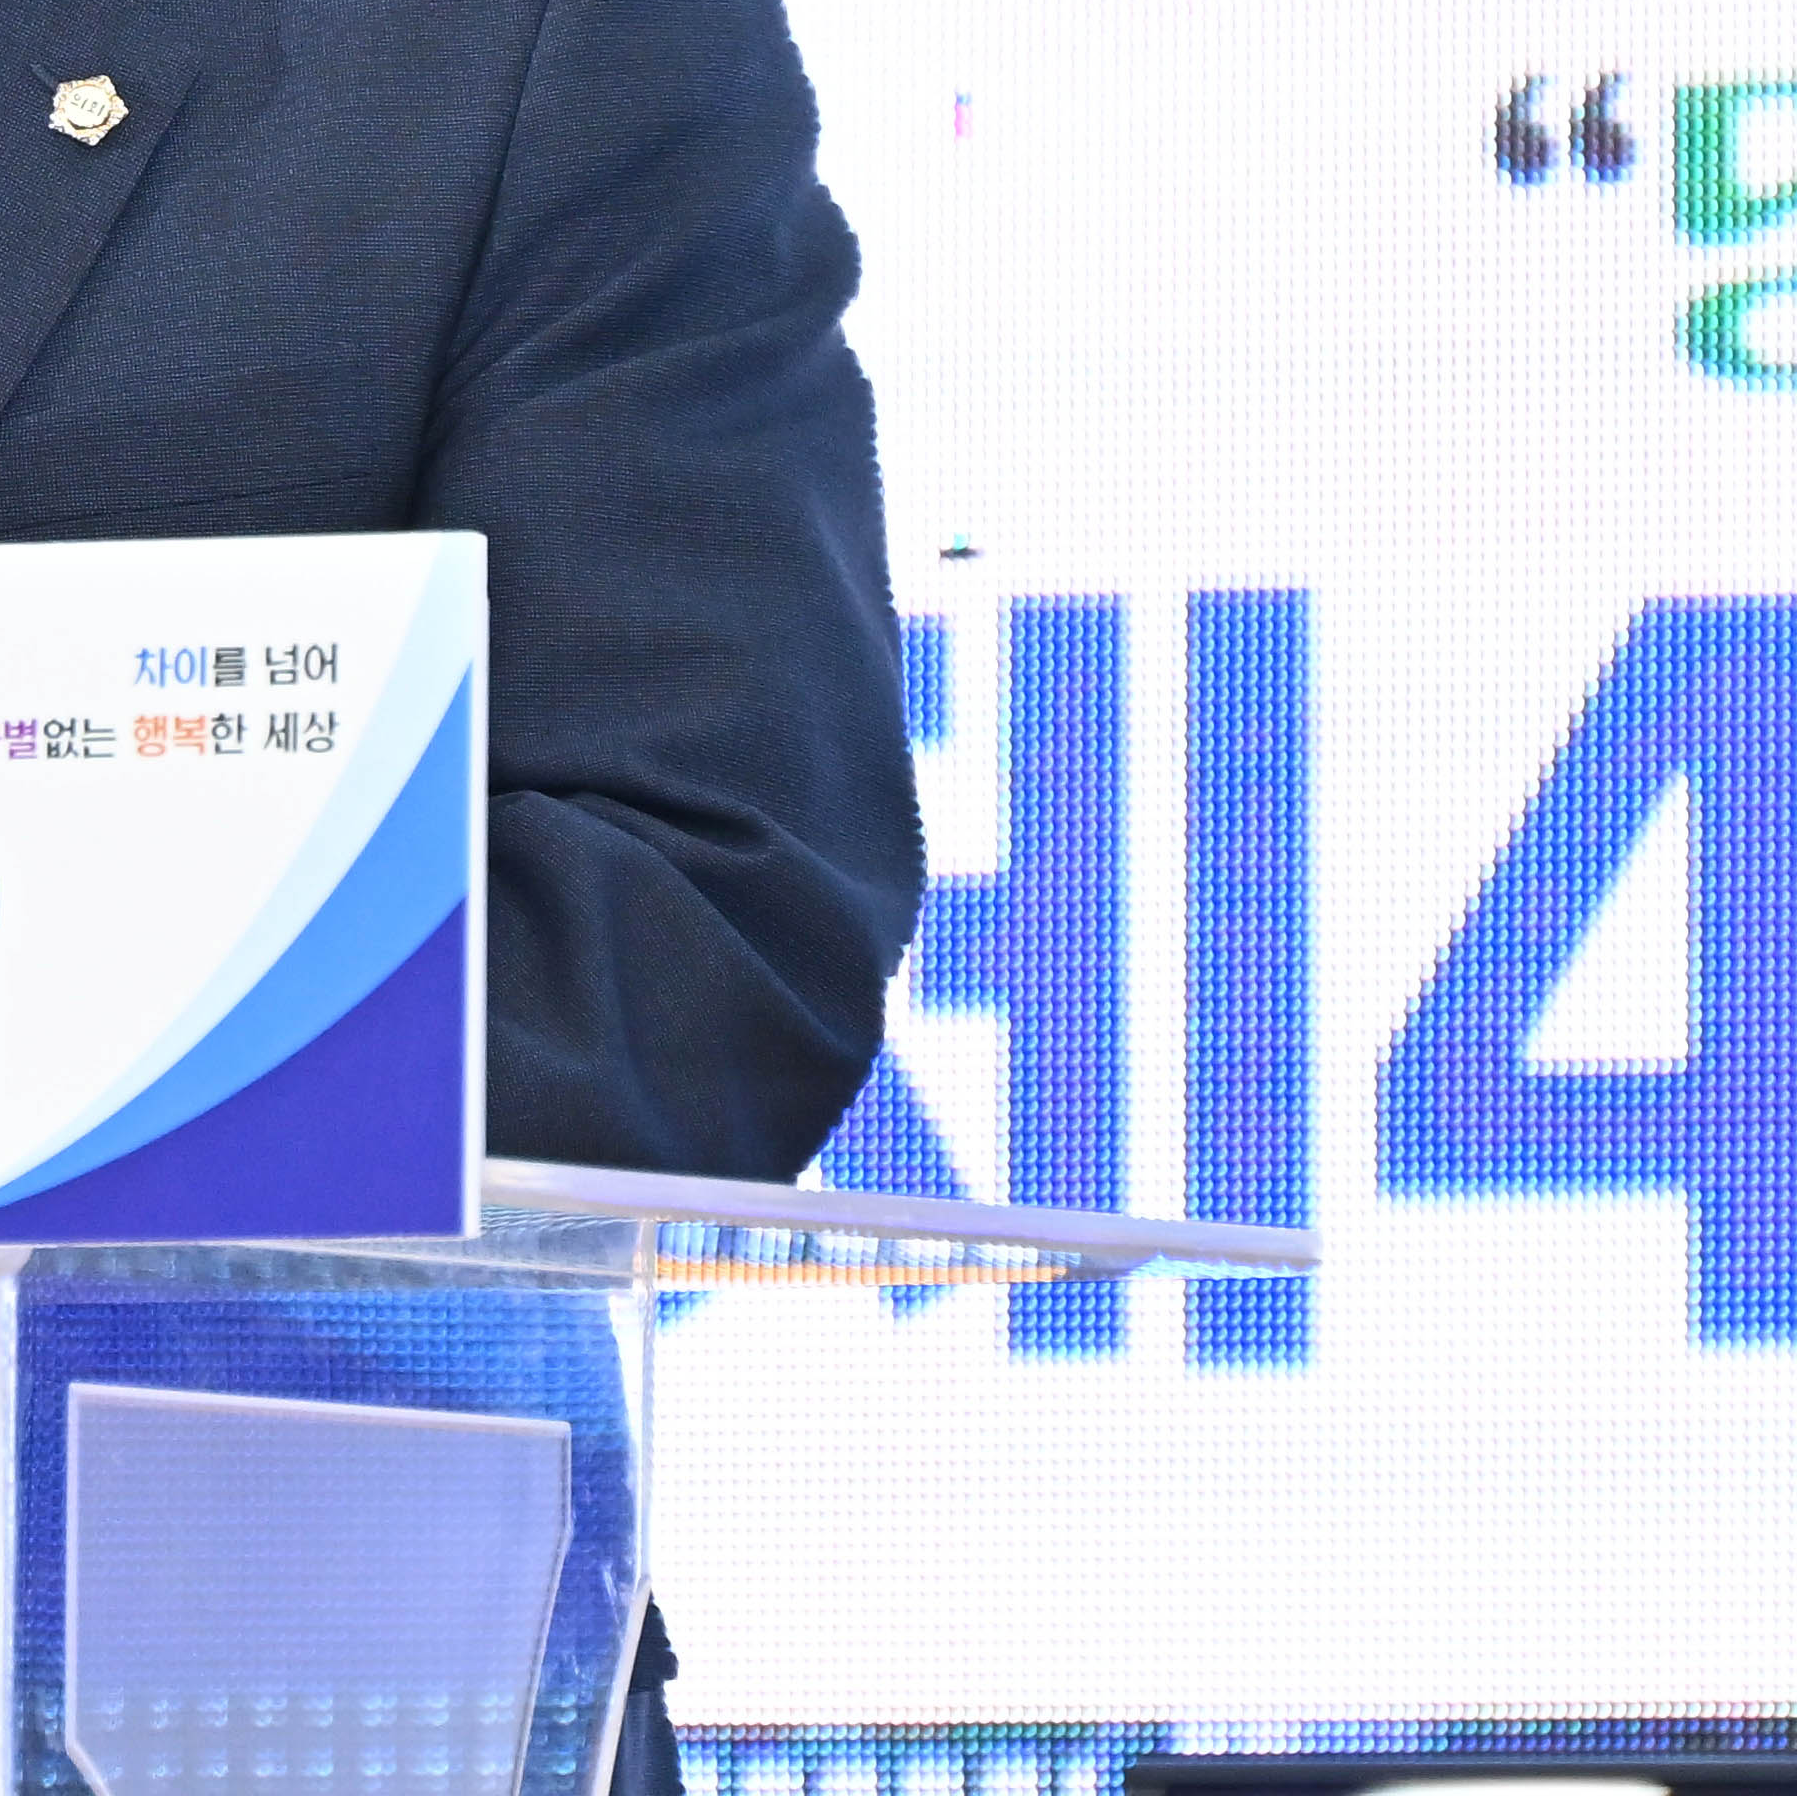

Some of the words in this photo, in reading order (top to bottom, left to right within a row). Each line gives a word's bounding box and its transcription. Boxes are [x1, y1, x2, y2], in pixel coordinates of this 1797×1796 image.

[136, 647, 248, 689] 차이를
[266, 644, 339, 686] 넘어
[134, 714, 248, 757] 행복한
[265, 712, 340, 754] 세상
